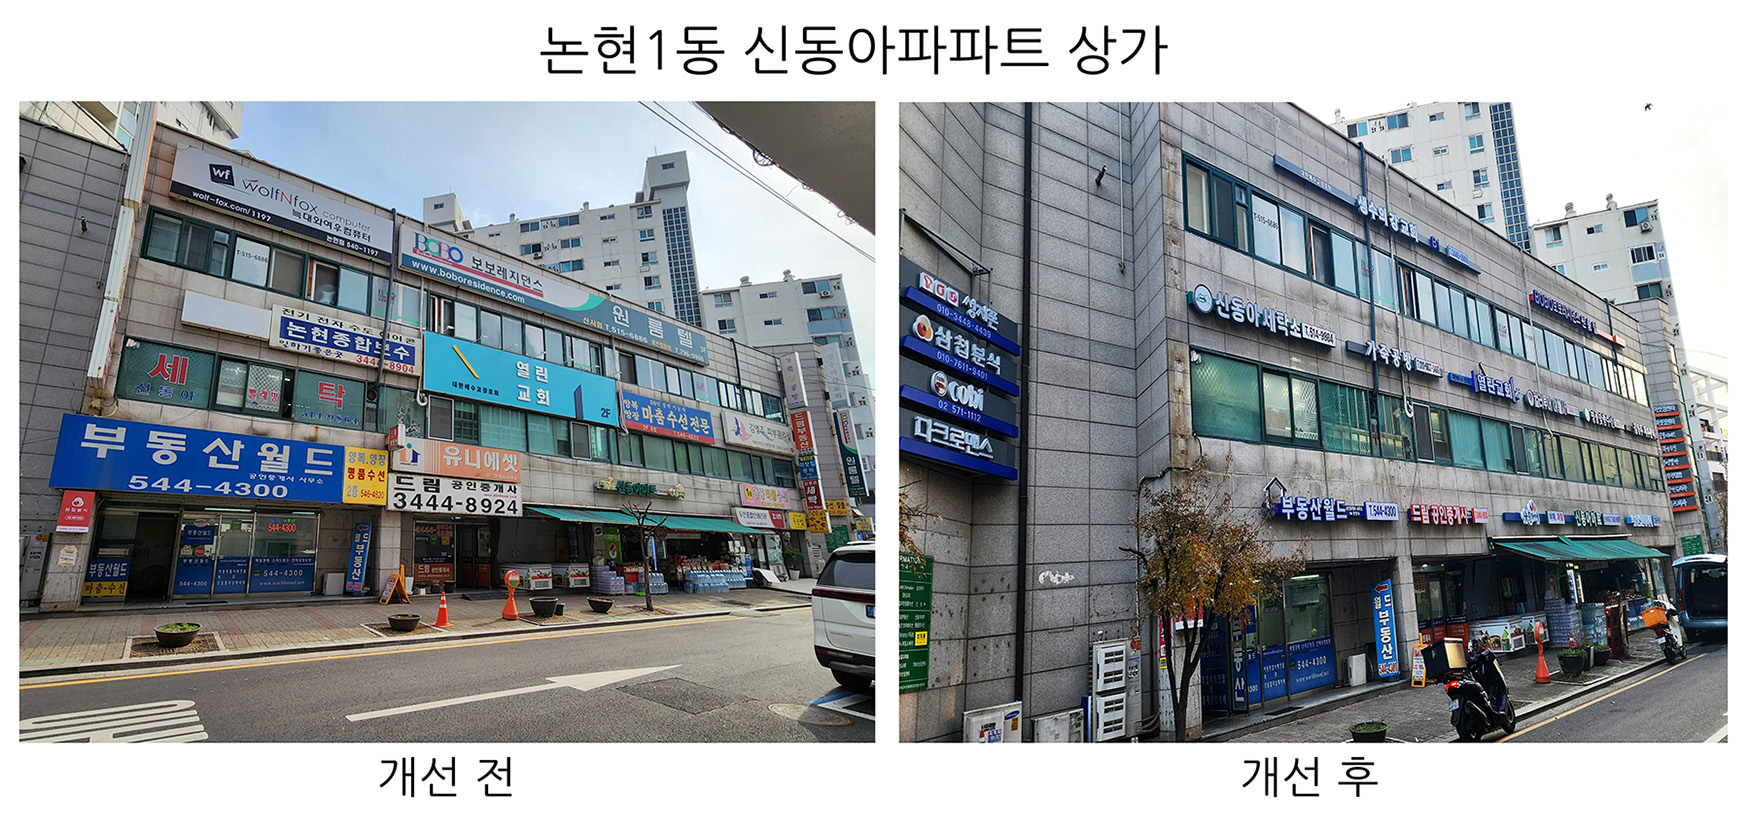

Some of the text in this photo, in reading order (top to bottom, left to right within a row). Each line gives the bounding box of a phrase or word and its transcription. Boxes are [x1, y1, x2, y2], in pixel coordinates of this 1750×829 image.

[192, 190, 271, 222] wolf-fox.com/1197
[292, 209, 371, 243] 늑대와여우컴퓨터
[322, 209, 371, 232] computer
[414, 232, 464, 264] BOBO
[411, 259, 526, 304] www.boboresidence.com
[471, 255, 544, 291] 보보레지던스
[282, 307, 309, 321] 전기
[318, 315, 343, 329] 전자
[349, 324, 374, 336] 수도
[1215, 291, 1302, 339] 신동아 세탁소
[287, 321, 410, 360] 논현종합보수
[934, 324, 1001, 375] 삼첩분식
[936, 351, 989, 381] 010-7611-9401
[1365, 340, 1412, 371] 가죽공방
[149, 353, 346, 409] 세 탁
[515, 360, 549, 384] 열린
[135, 383, 195, 402] 신동아
[517, 384, 550, 407] 교회
[948, 379, 984, 412] cobi
[1476, 373, 1513, 400] 열린교회
[600, 407, 611, 419] 2F
[623, 399, 638, 410] 양복
[624, 409, 639, 421] 양장
[938, 400, 981, 423] 02 571-1112
[301, 409, 359, 426] 514-9864
[914, 415, 994, 459] 다크로맨스
[81, 424, 334, 476] 부동산월드
[443, 445, 518, 473] 유니에셋
[249, 471, 324, 486] 공인중개사 사무소
[347, 467, 386, 482] 명품수선
[394, 475, 517, 494] 드림 공인중개사
[128, 475, 289, 499] 544-4300
[346, 484, 385, 500] 2층 546-4820
[393, 492, 518, 515] 3444-8924
[1281, 496, 1348, 521] 부동산월드
[1368, 504, 1397, 518] T.544-4300
[1410, 504, 1430, 524] 드림
[1430, 504, 1468, 527] 공인중개사
[267, 523, 296, 533] 544-4300
[89, 562, 128, 578] 부동산월드
[263, 569, 304, 577] 544-4300
[351, 543, 366, 581] 부동산
[1378, 610, 1394, 660] 부동산
[1297, 655, 1327, 671] 544-4300
